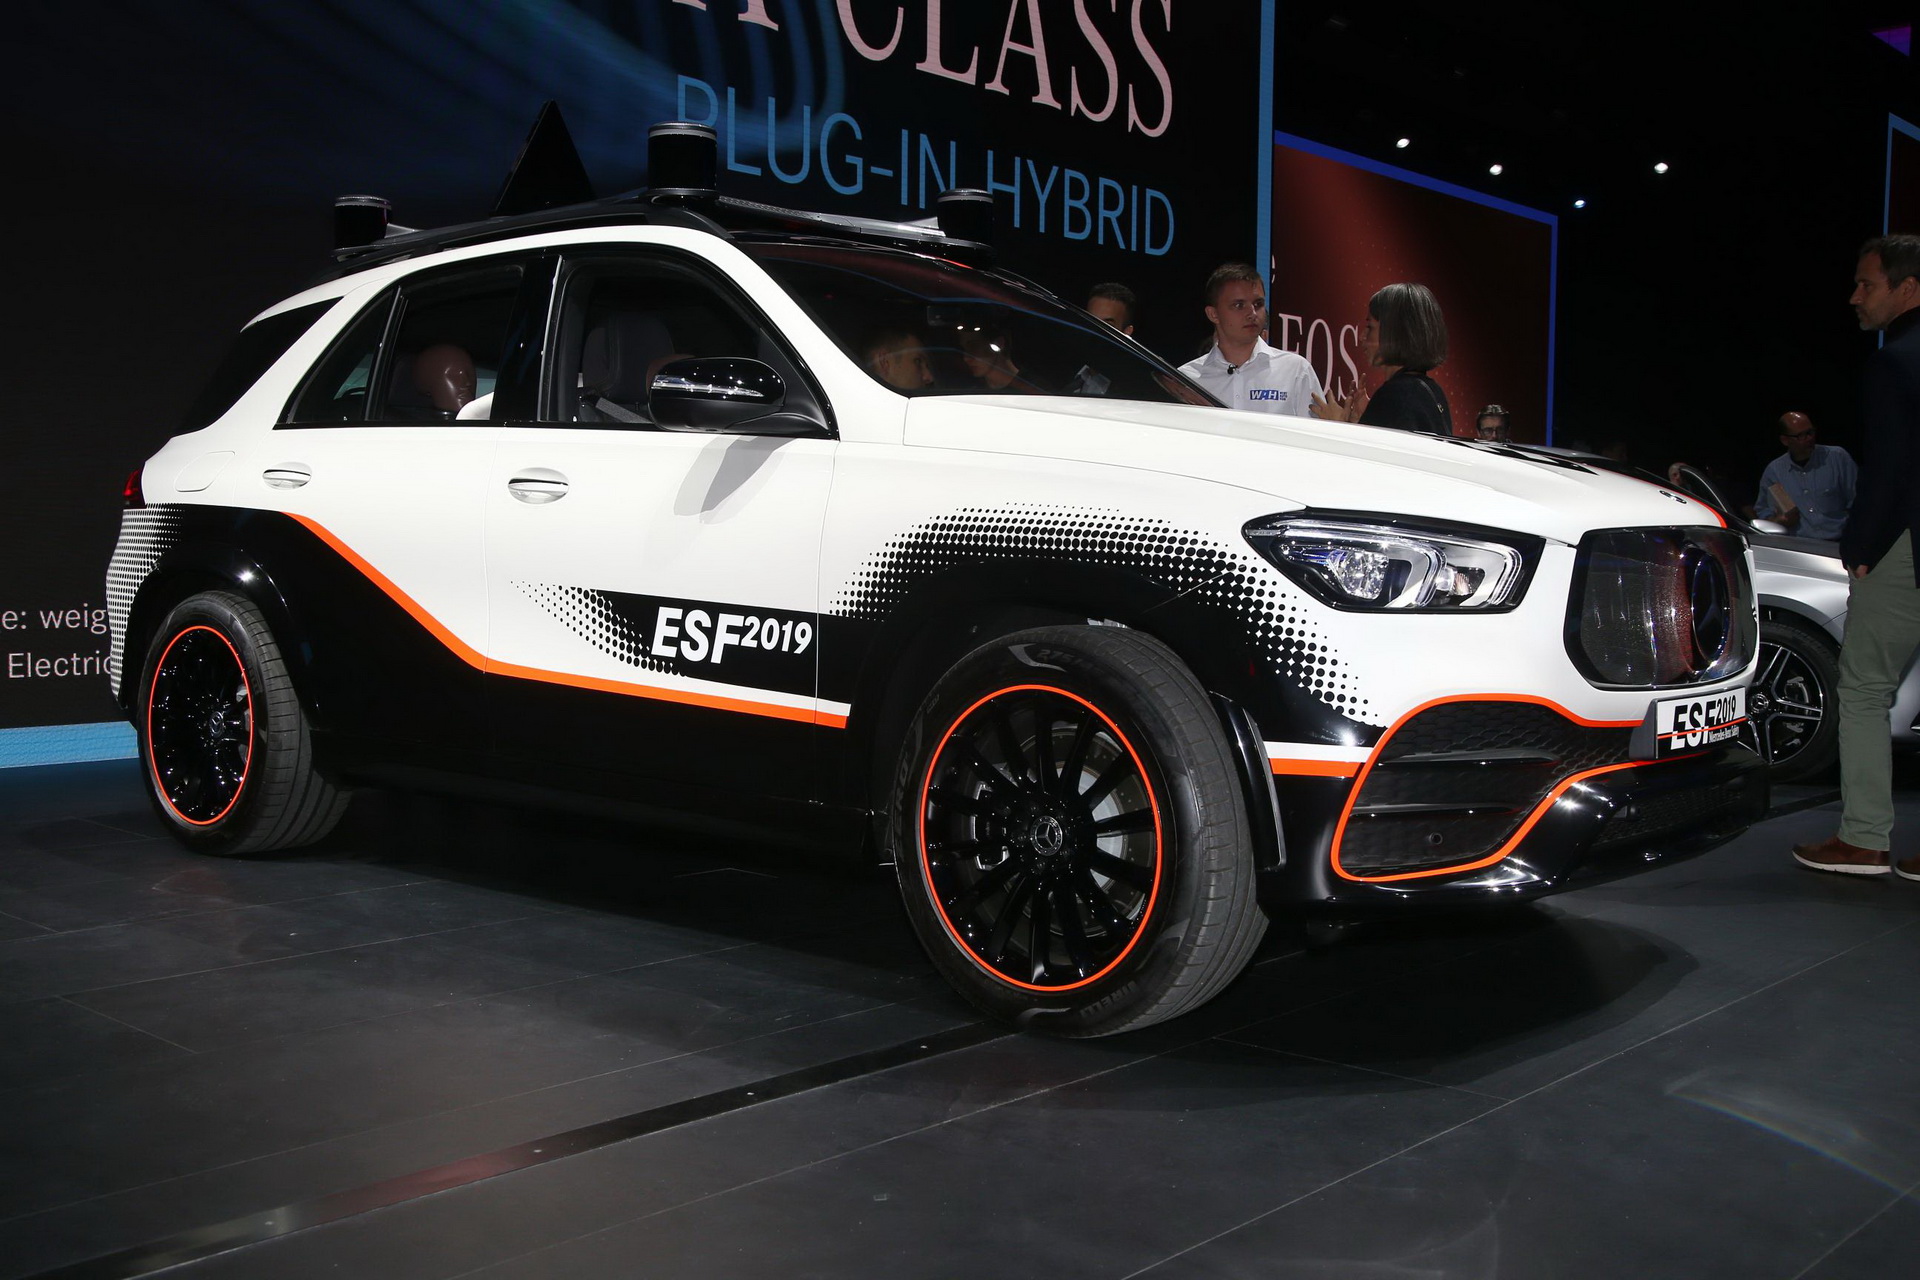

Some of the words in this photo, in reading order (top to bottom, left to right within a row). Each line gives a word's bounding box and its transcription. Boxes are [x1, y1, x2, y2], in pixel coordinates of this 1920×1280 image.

[677, 75, 956, 209] PLUG-IN
[986, 150, 1175, 256] HYBRID
[39, 602, 107, 635] weig
